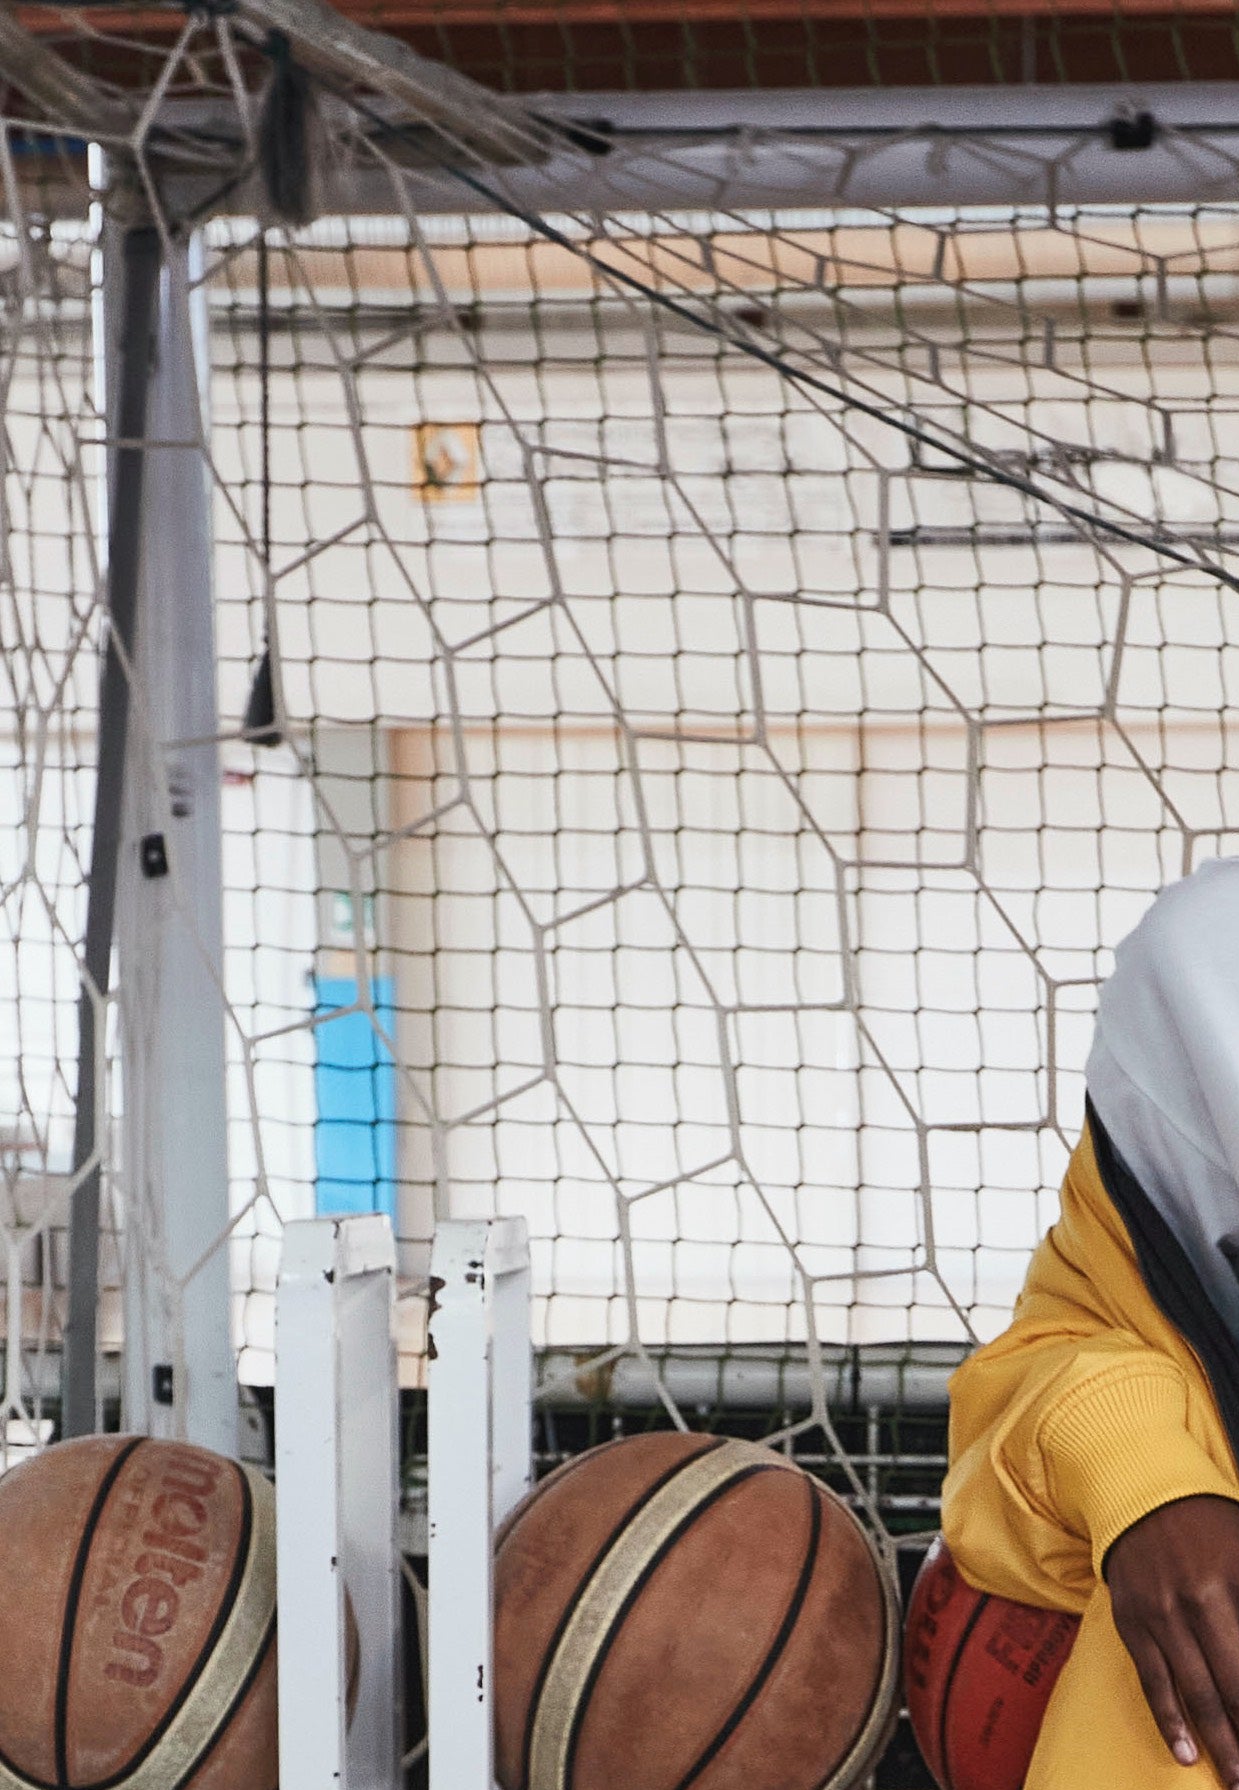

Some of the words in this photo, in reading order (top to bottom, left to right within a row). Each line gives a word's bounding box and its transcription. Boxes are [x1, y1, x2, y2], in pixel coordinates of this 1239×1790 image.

[104, 1450, 221, 1687] molten
[986, 1604, 1050, 1676] FIB
[1023, 1613, 1080, 1687] APPROV
